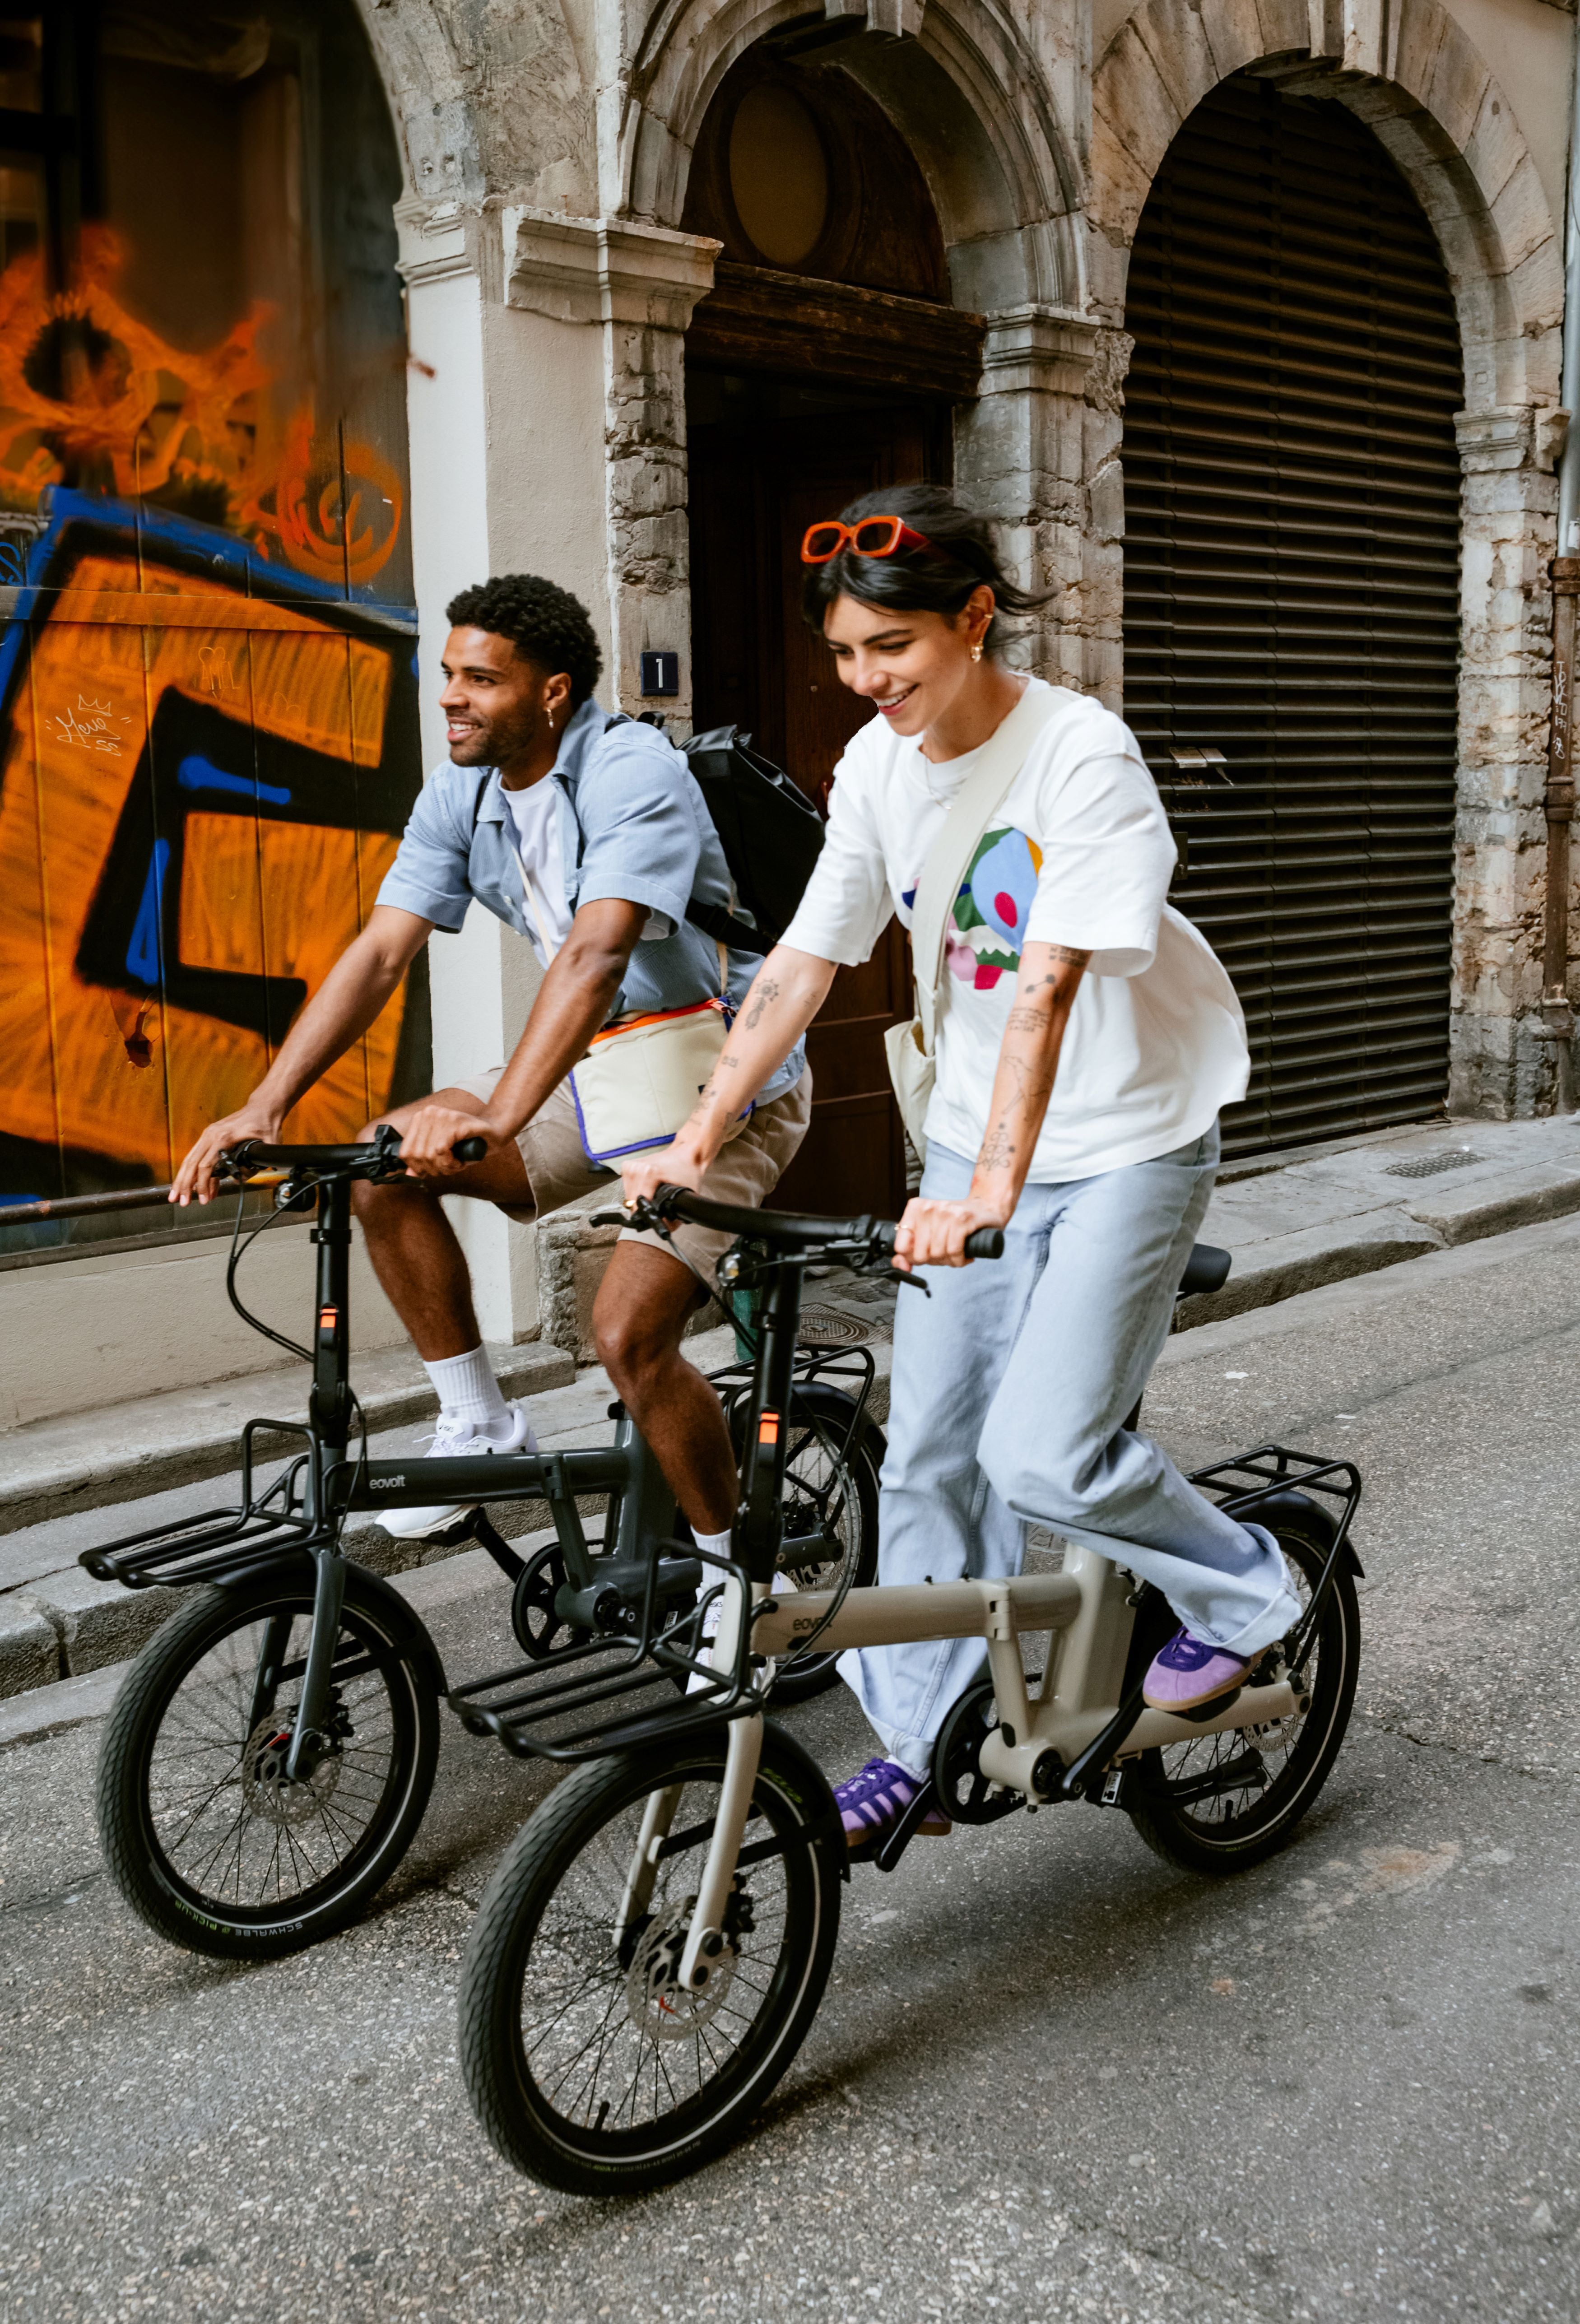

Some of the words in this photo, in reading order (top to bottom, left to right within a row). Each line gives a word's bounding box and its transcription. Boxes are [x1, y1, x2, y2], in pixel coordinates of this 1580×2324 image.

[656, 658, 663, 688] 1
[369, 1475, 406, 1489] eovolt
[793, 1616, 832, 1631] eov
[234, 1921, 303, 1937] SCHWALBE
